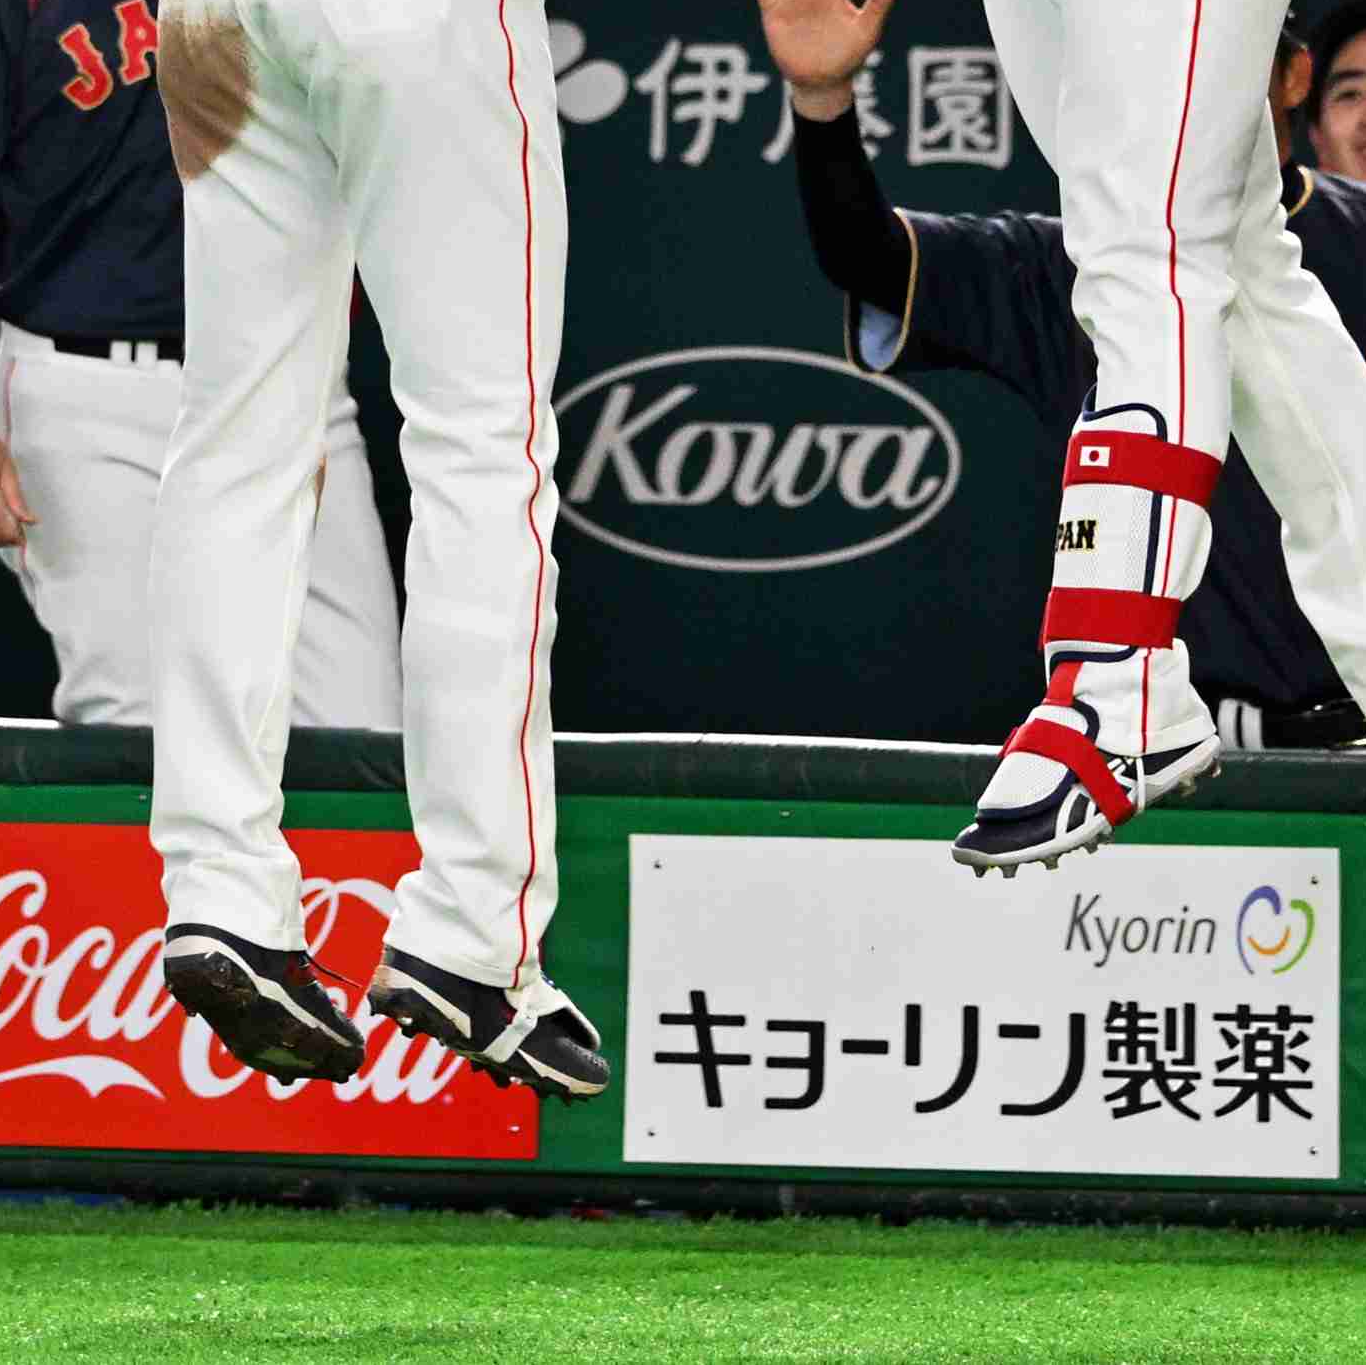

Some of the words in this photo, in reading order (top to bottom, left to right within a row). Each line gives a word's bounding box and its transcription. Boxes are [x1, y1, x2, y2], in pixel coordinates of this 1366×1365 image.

[567, 383, 943, 509] Kowa
[1064, 892, 1217, 968] Kyorin
[653, 989, 1316, 1124] キョーリン製薬
